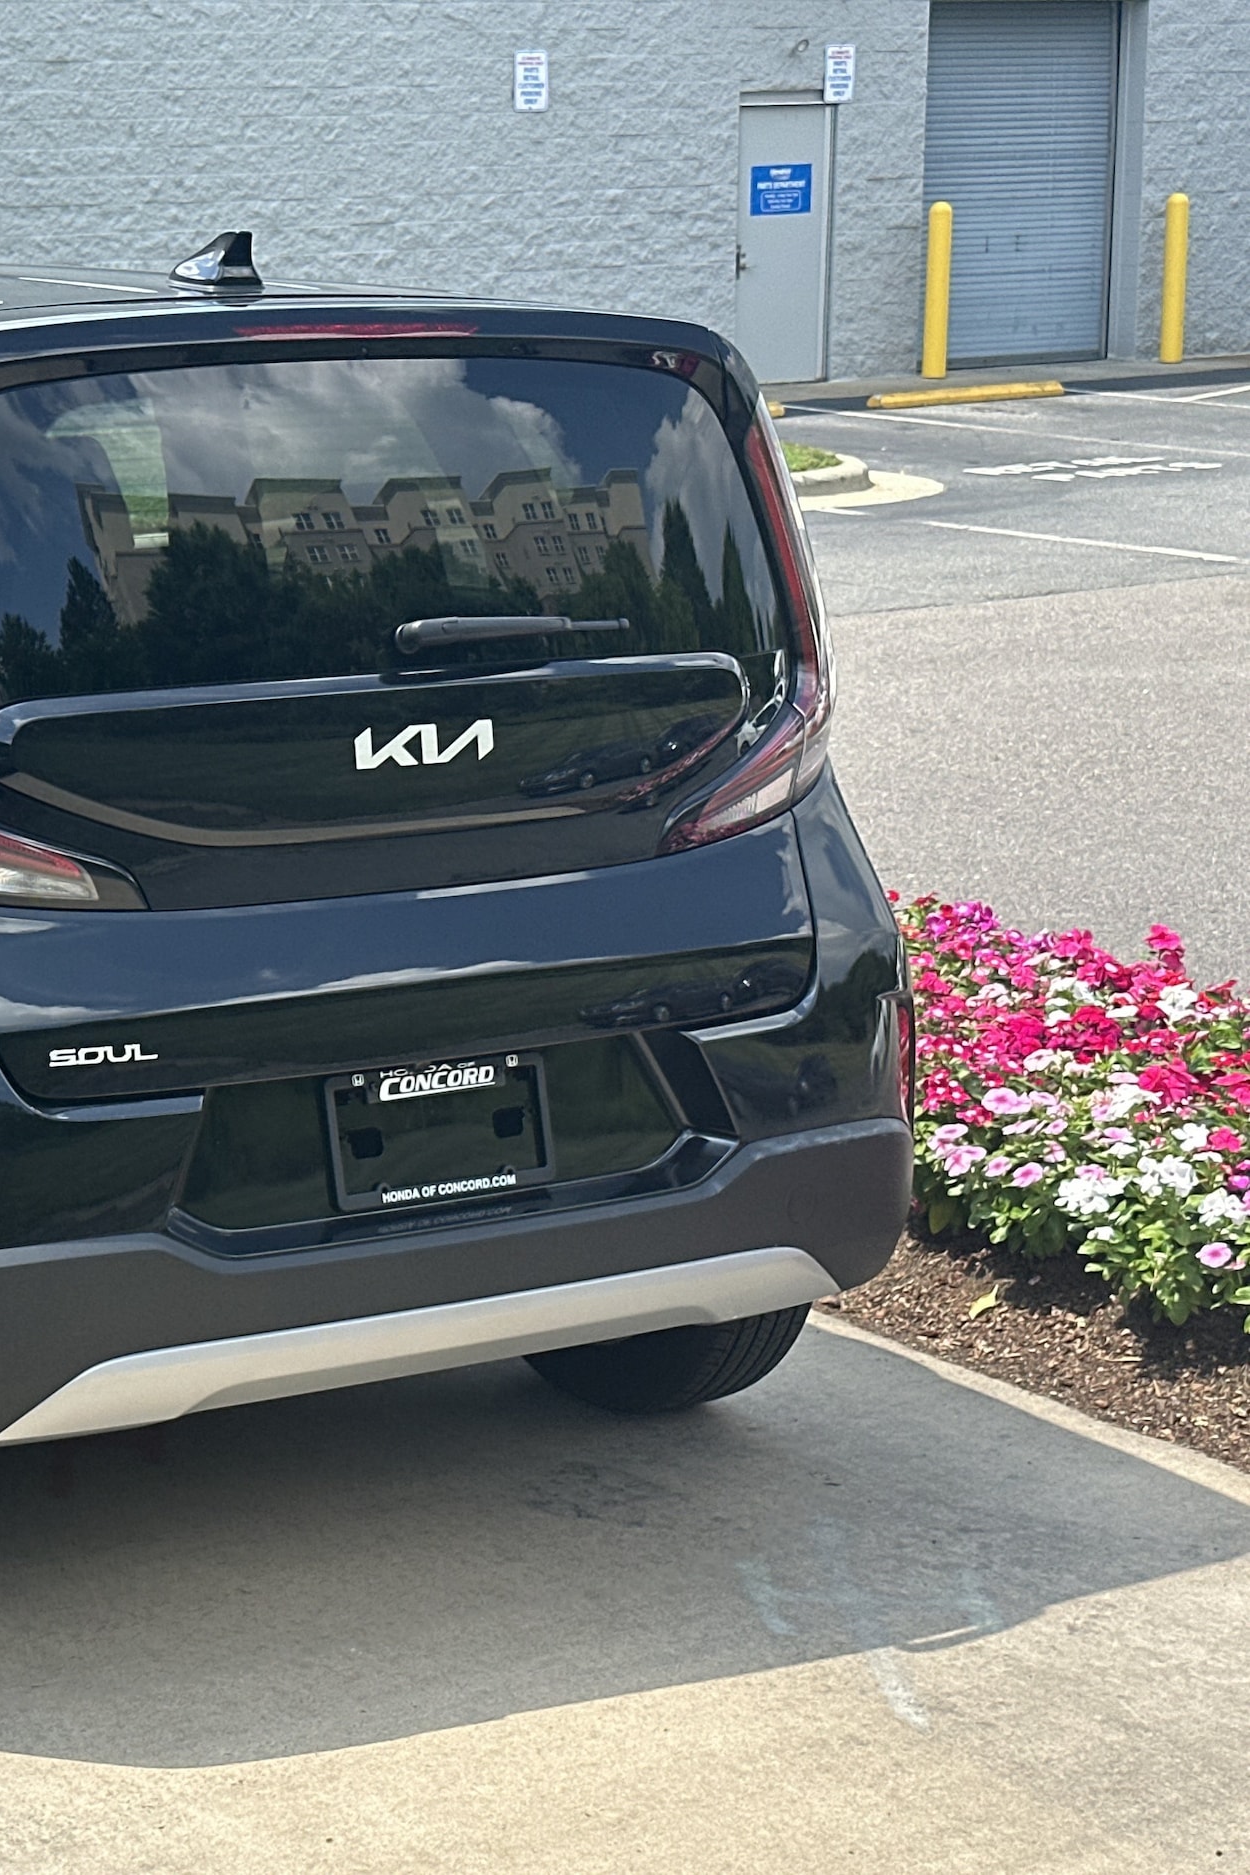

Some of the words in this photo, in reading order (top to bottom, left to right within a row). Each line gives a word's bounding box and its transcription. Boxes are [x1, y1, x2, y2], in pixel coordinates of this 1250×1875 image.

[49, 1043, 158, 1067] SOUL
[379, 1063, 452, 1079] HODA
[379, 1065, 495, 1101] CONCORD
[382, 1188, 420, 1203] HONDA
[422, 1184, 437, 1198] OF
[438, 1174, 516, 1196] CONCORD.COM
